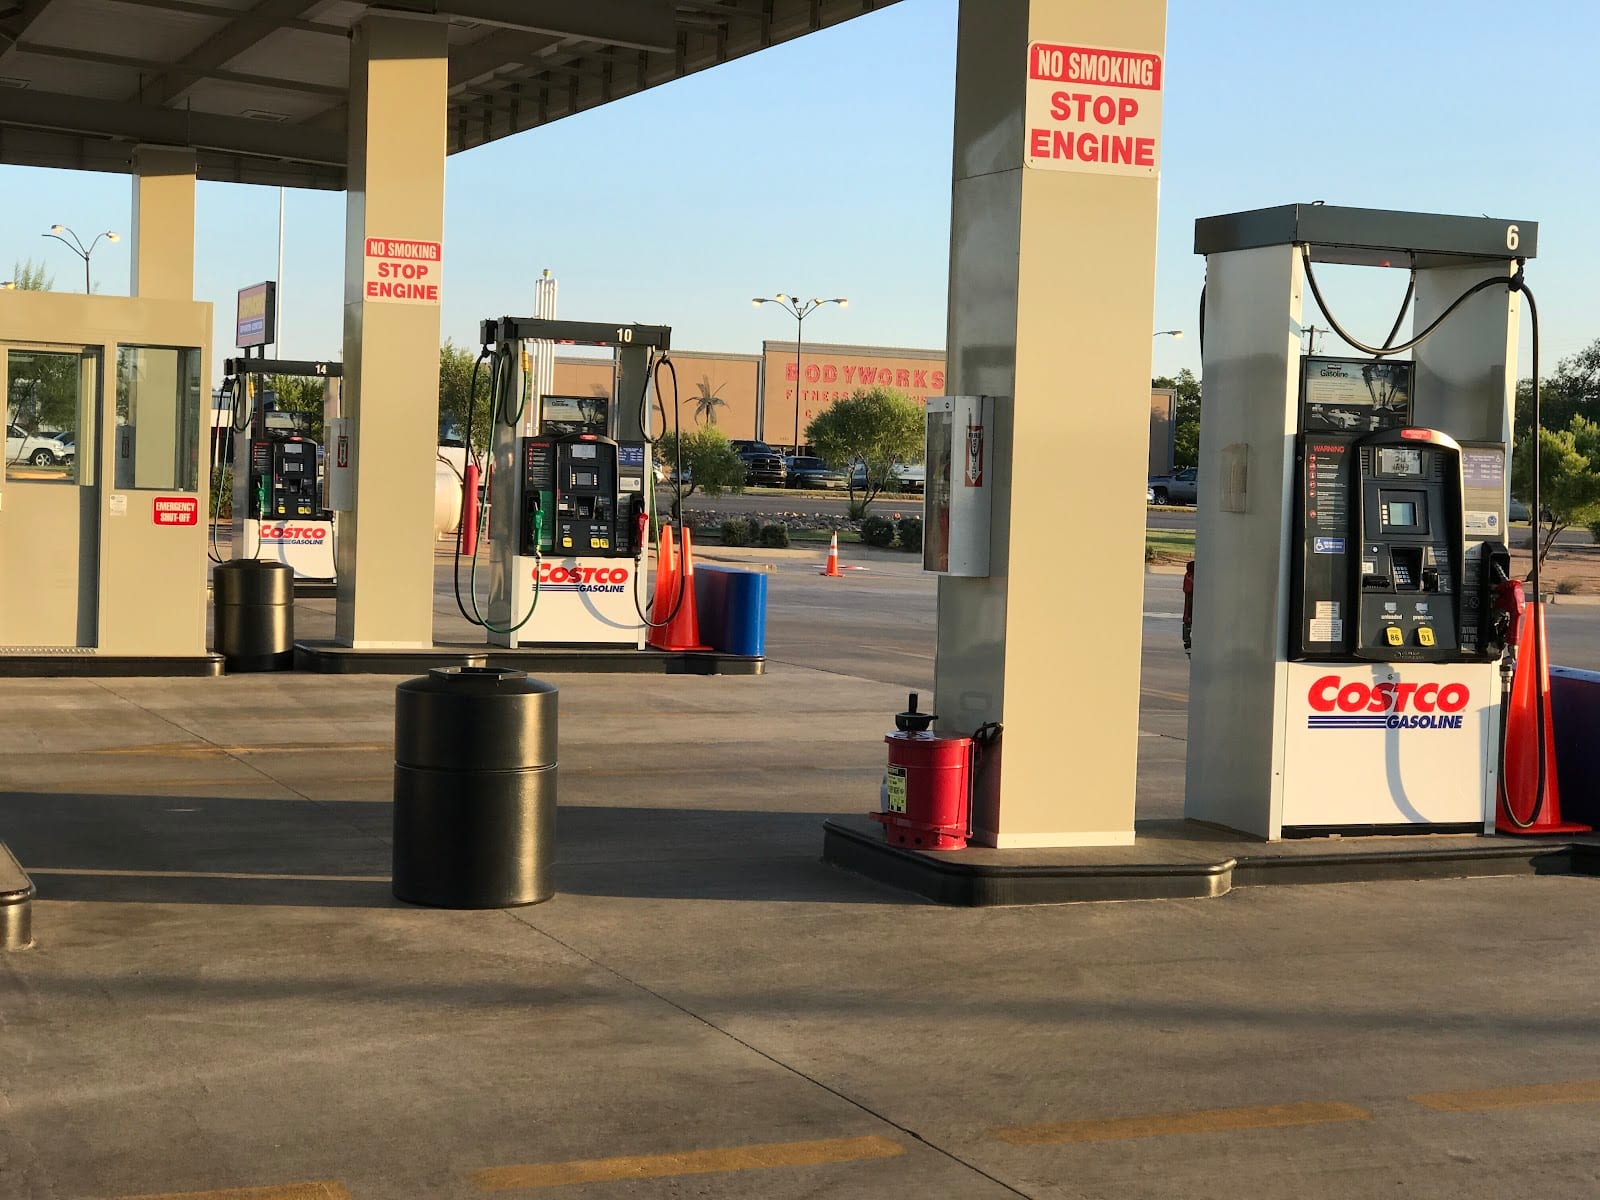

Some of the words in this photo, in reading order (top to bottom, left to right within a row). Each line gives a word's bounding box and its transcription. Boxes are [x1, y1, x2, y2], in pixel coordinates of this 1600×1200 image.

[1037, 49, 1064, 78] NO
[1068, 52, 1154, 86] SMOKING
[1050, 91, 1139, 126] STOP
[1030, 128, 1155, 167] ENGINE
[1506, 224, 1519, 251] 6
[370, 241, 385, 256] NO
[387, 242, 437, 259] SMOKING
[377, 262, 429, 280] STOP
[366, 281, 438, 300] ENGINE
[616, 328, 632, 343] 10
[315, 364, 327, 375] 14
[785, 363, 945, 389] BODYWORKS
[1320, 369, 1349, 378] Gasoline
[785, 389, 849, 401] FTNESS
[1313, 445, 1345, 453] WARNING
[156, 502, 196, 512] EMERGENCY
[160, 513, 191, 522] SHUT-OFF
[258, 525, 327, 539] COSTCO
[531, 563, 629, 584] COSTCO
[579, 585, 625, 593] GASOLINE
[1307, 675, 1471, 713] COSTCO
[1386, 715, 1463, 729] GASOLINE
